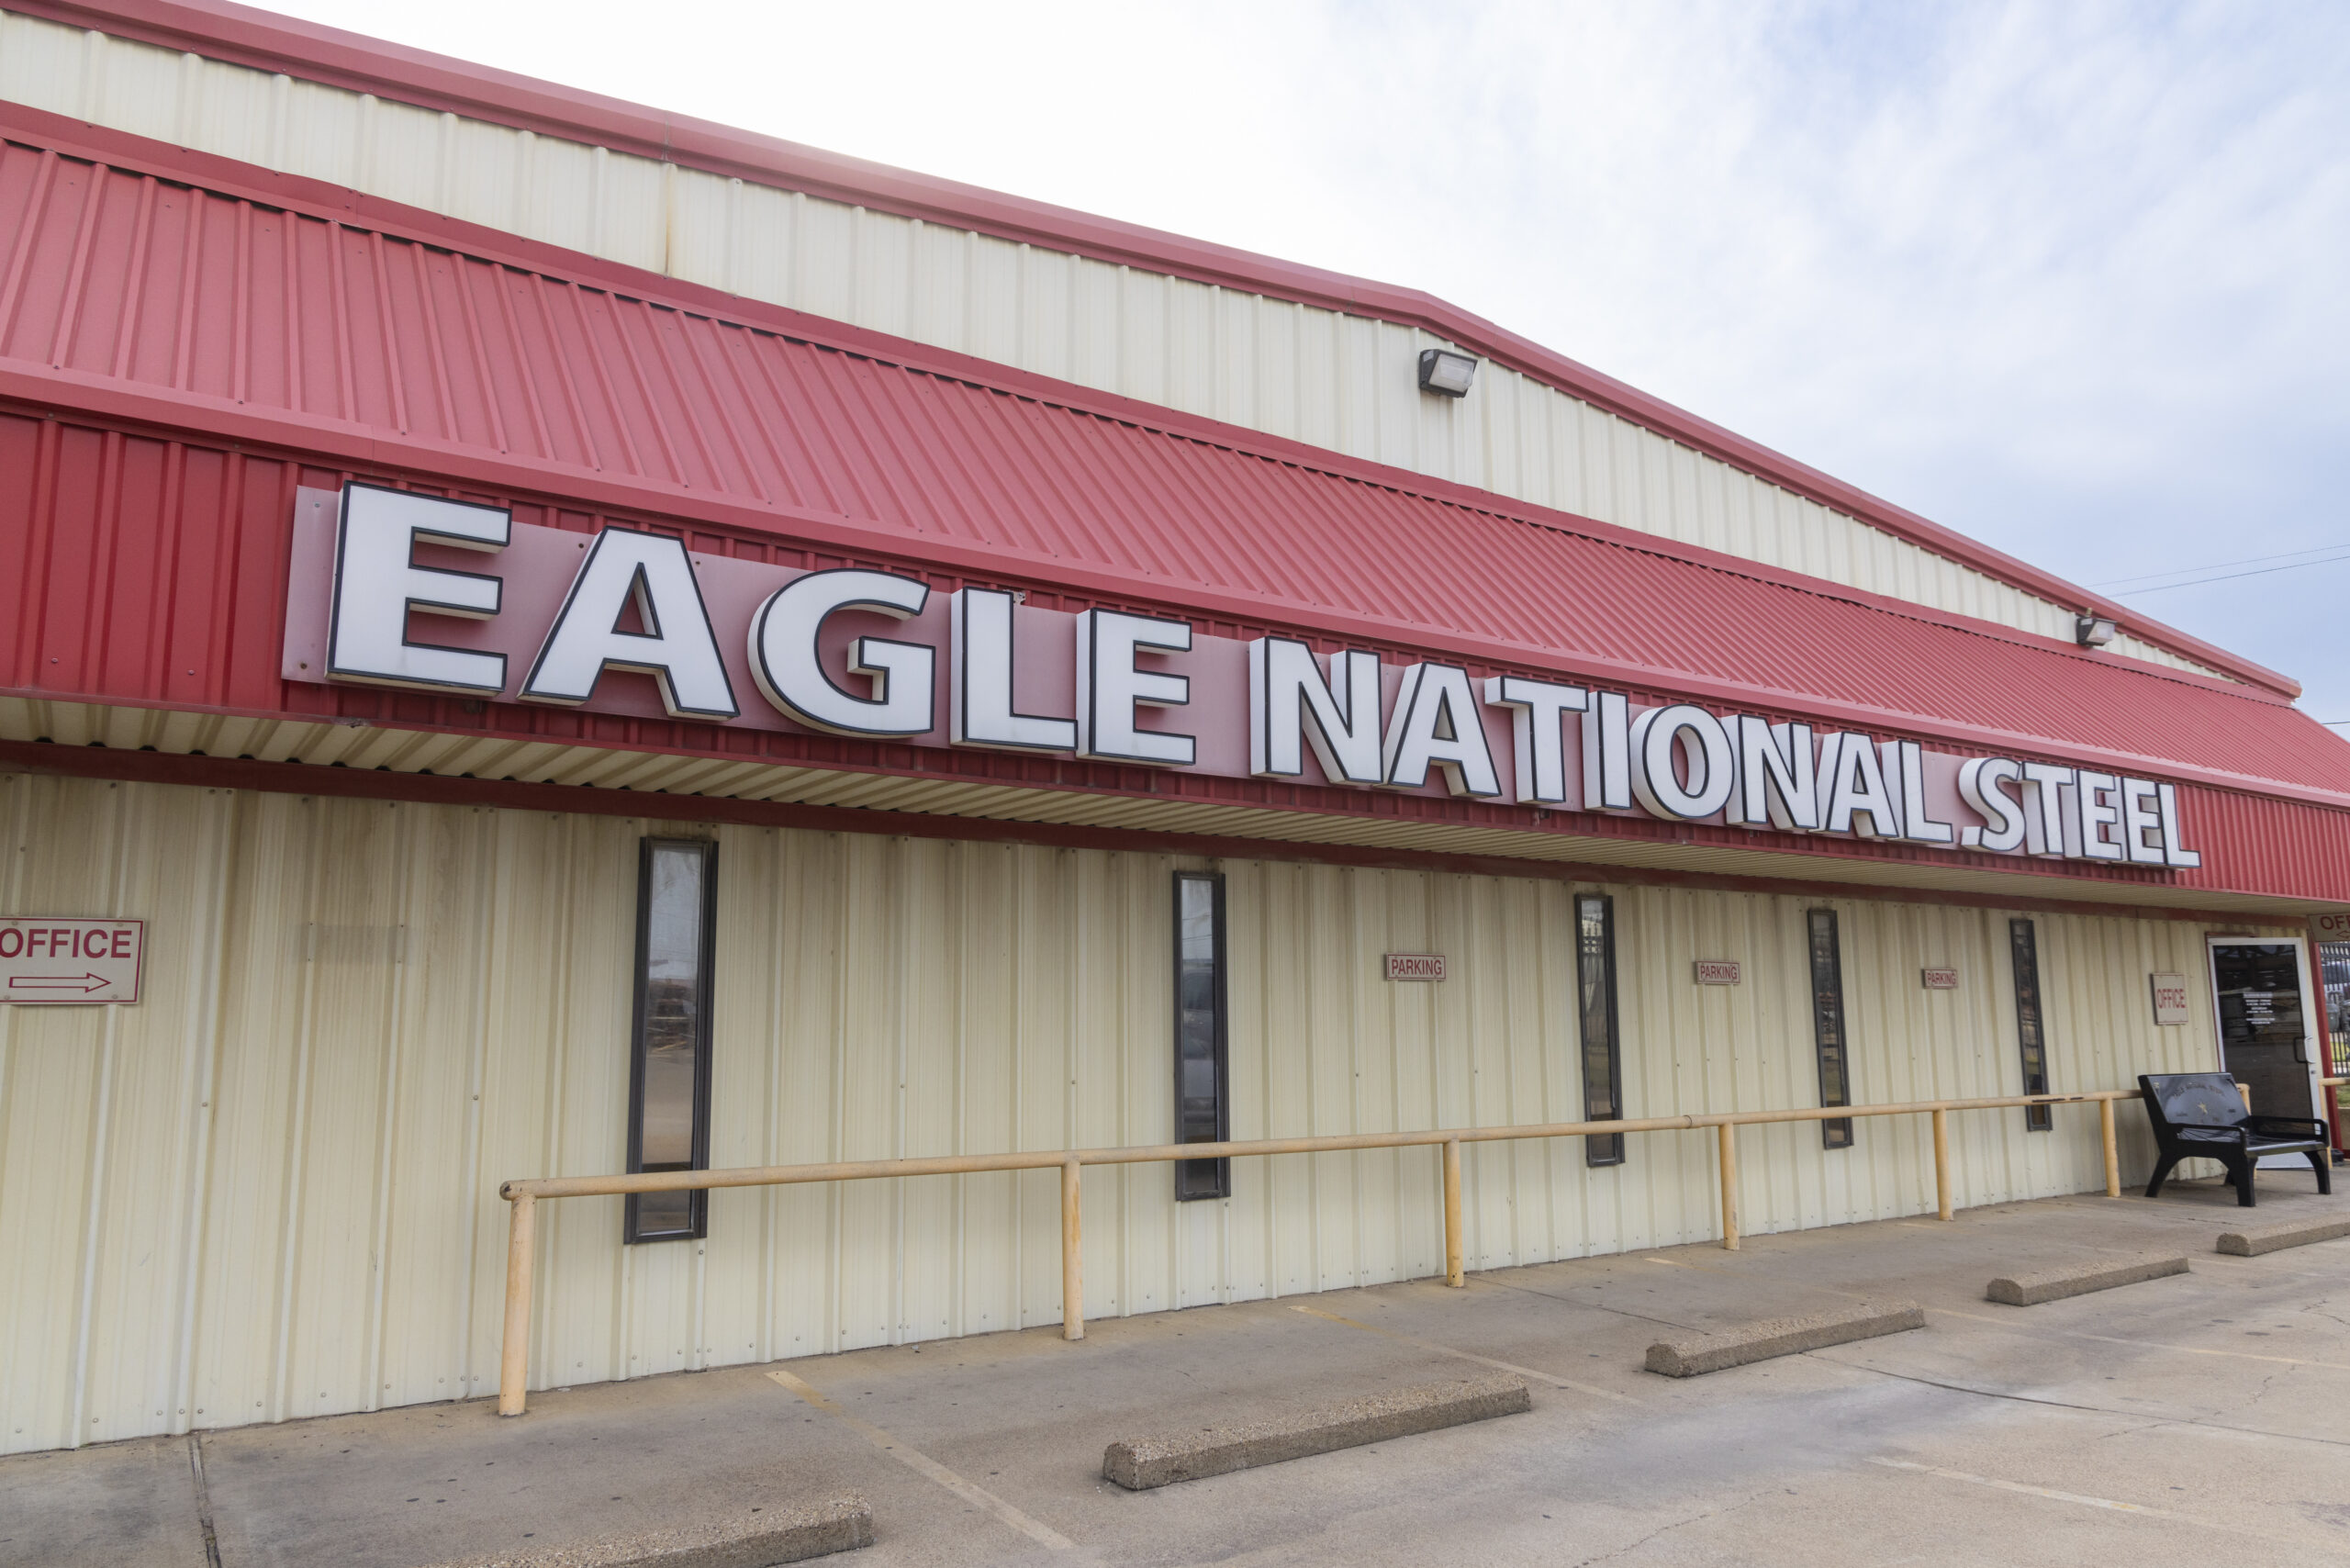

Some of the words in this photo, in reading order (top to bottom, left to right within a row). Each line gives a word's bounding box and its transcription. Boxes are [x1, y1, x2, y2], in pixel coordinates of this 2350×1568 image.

[325, 479, 1197, 766] EAGLE
[1249, 634, 1953, 844] NATIONAL
[1960, 756, 2201, 868] STEEL
[0, 927, 132, 959] OFFICE
[1391, 958, 1442, 976] PARKING
[1699, 964, 1738, 980] PARKING
[1927, 972, 1957, 985] PARKING
[2157, 988, 2186, 1008] OFFICE
